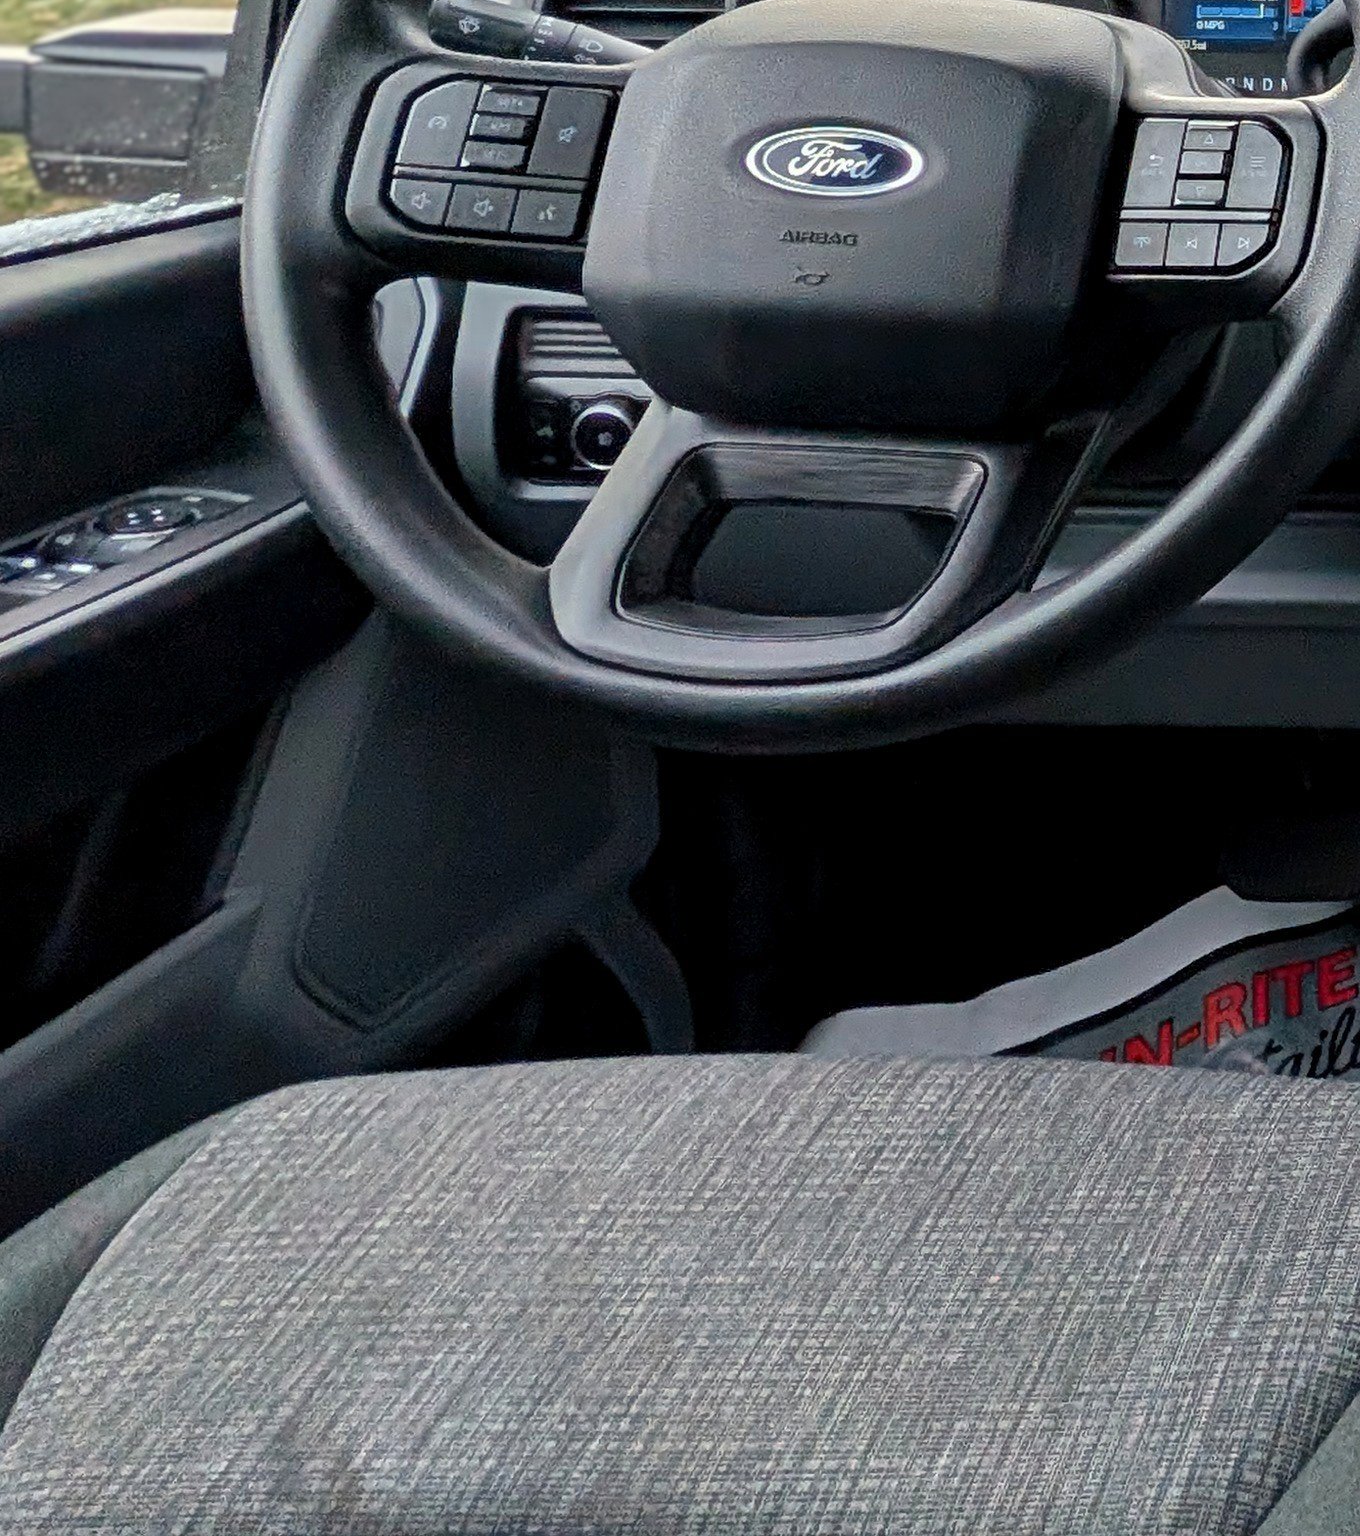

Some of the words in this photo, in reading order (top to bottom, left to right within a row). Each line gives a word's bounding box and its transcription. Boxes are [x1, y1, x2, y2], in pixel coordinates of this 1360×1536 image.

[1243, 77, 1254, 91] N
[1262, 77, 1273, 91] D
[787, 139, 883, 179] Ford
[780, 229, 858, 246] AIRBAG
[1100, 943, 1360, 1067] N-RITE
